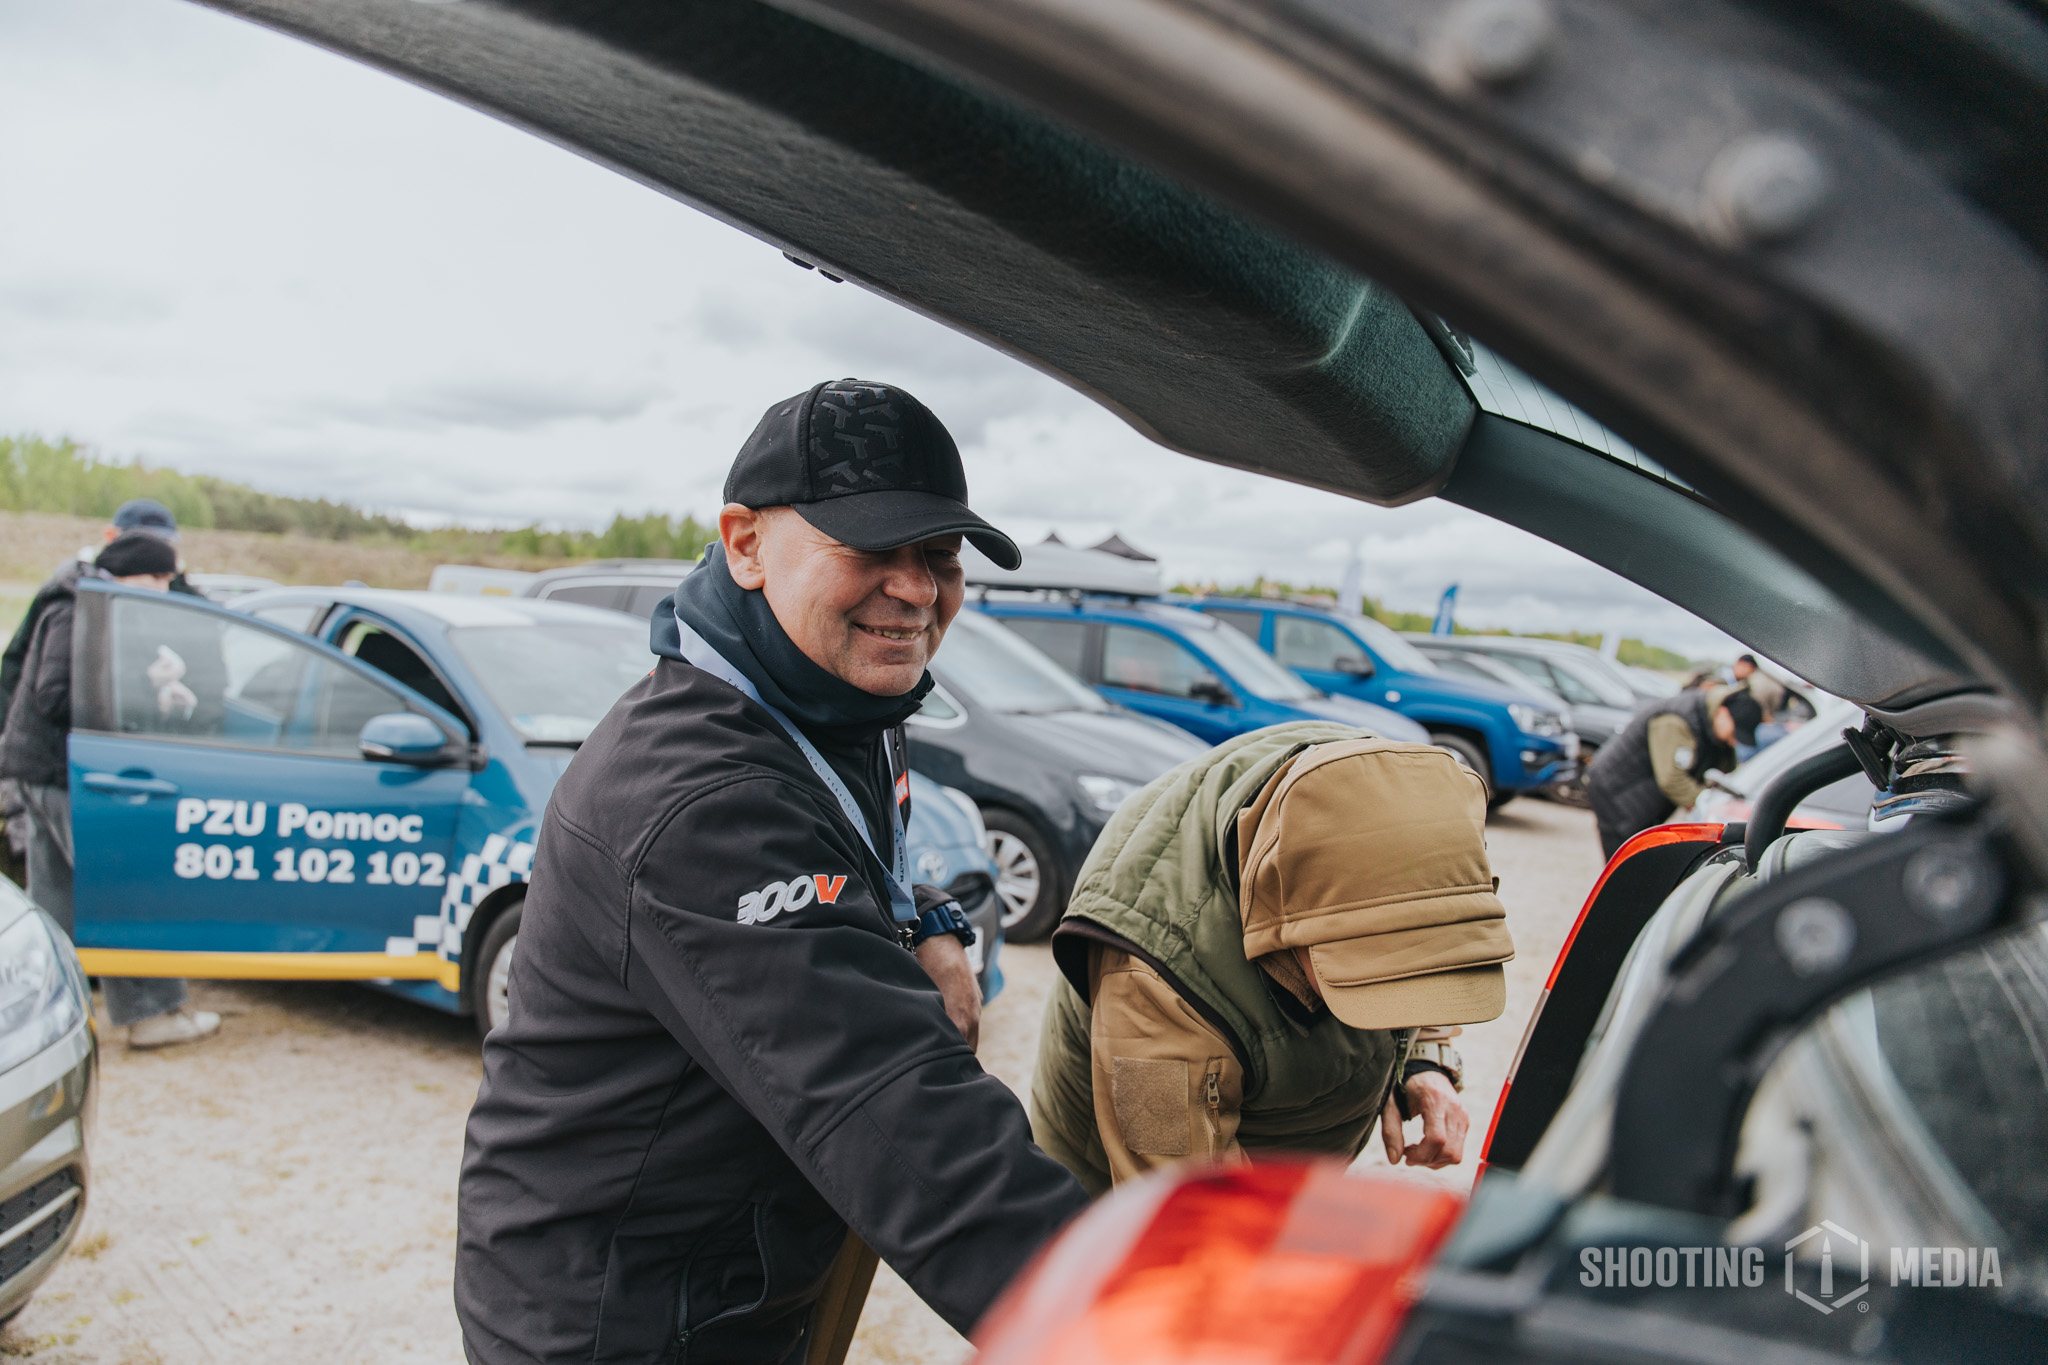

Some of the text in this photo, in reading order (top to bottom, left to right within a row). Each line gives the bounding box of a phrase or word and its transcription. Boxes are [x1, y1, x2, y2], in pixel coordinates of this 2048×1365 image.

[176, 798, 424, 843] PZU Pomoc
[174, 843, 446, 886] 801 102 102
[737, 874, 848, 925] 300V
